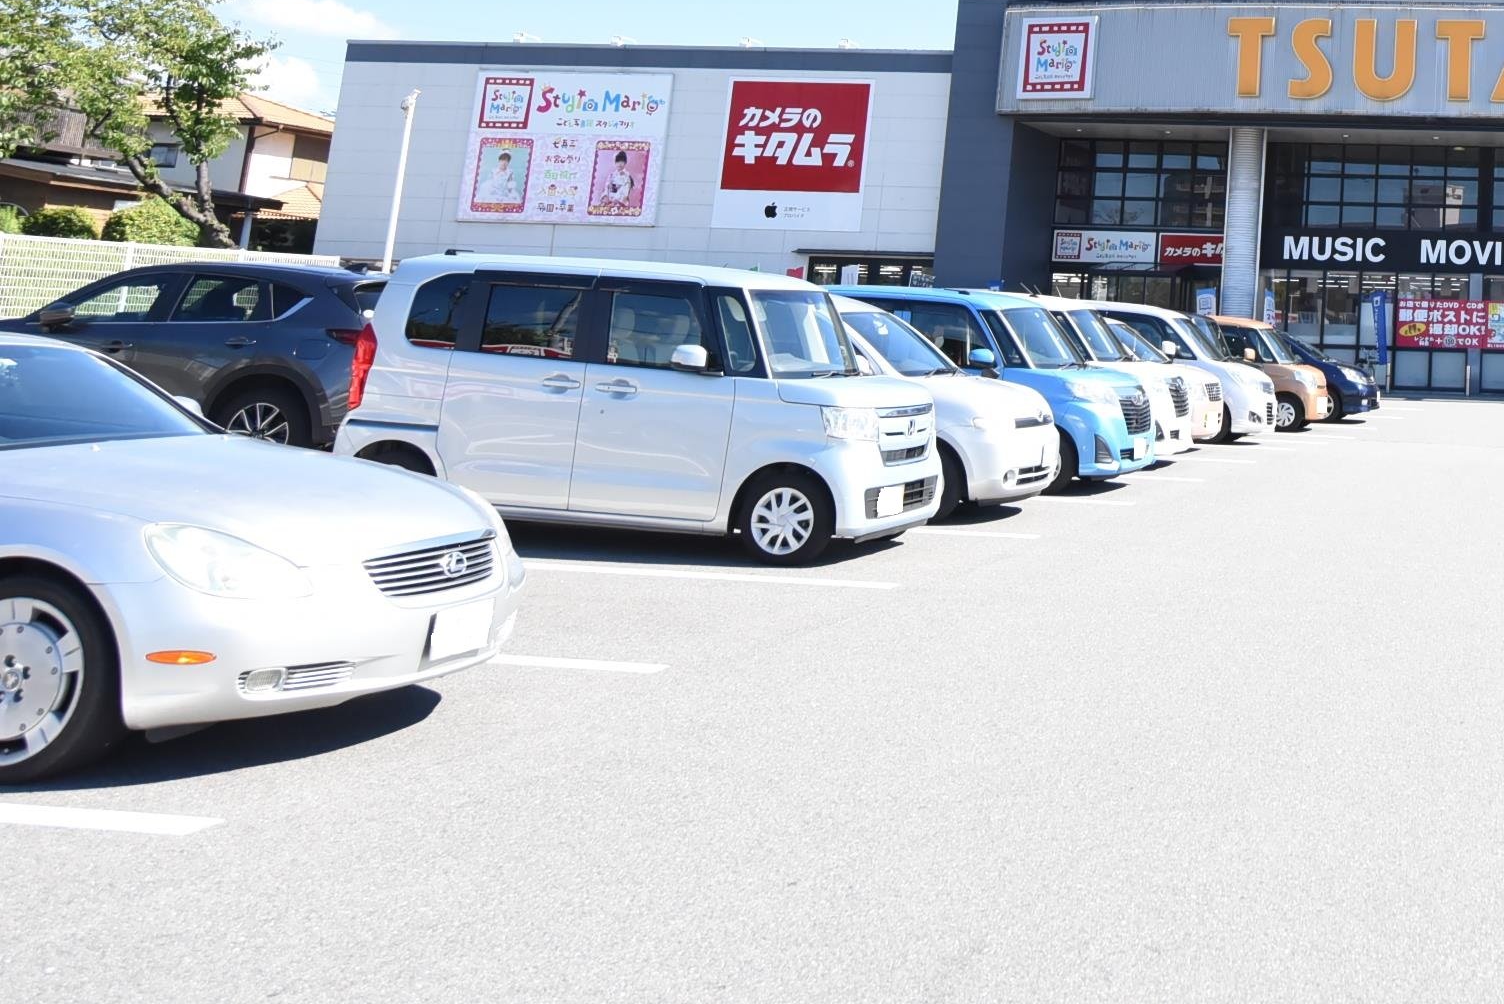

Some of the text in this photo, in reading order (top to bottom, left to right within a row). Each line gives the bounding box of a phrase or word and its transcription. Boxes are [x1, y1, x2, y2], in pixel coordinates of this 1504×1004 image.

[1037, 39, 1078, 57] Studio
[1036, 57, 1077, 72] Mario
[536, 83, 665, 116] Studio Mario
[737, 106, 822, 128] カメラの
[731, 131, 856, 167] キタムラ
[1283, 236, 1386, 264] MUSIC
